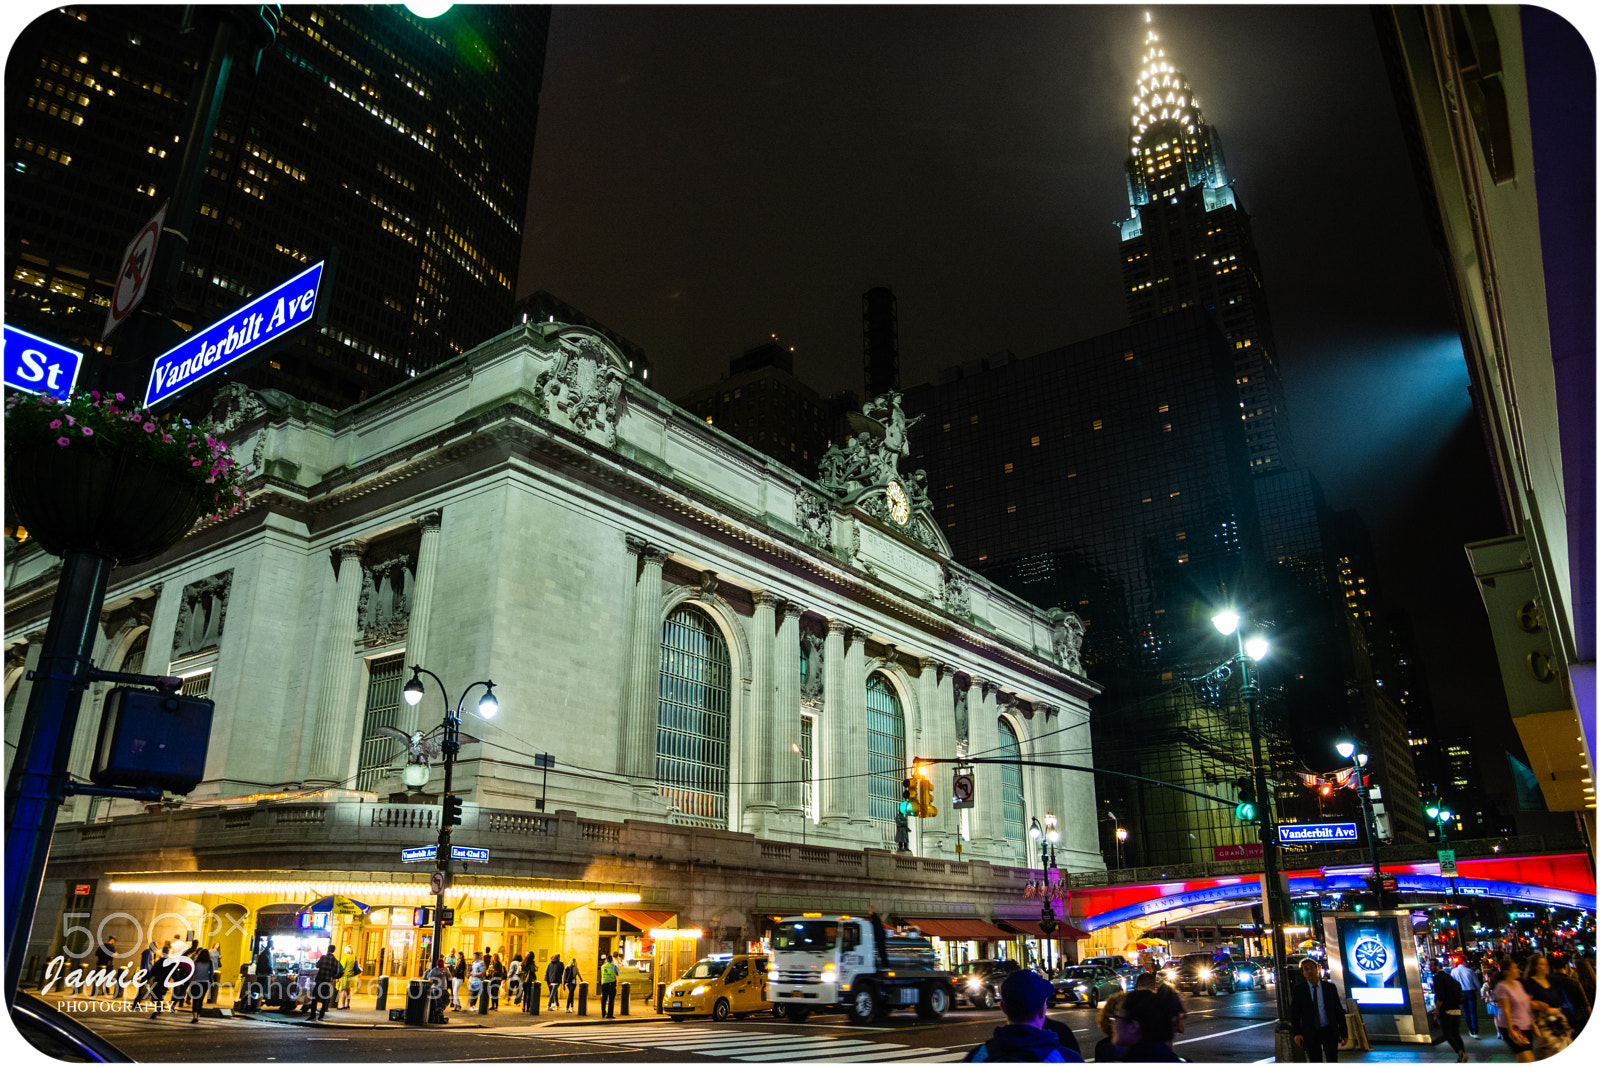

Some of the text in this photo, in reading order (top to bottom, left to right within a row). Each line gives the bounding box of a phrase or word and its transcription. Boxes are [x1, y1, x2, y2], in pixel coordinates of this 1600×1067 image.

[155, 288, 315, 394] Vanderbilt Ave
[17, 349, 63, 390] St
[1281, 827, 1355, 839] Vanderbilt Ave
[453, 849, 487, 859] East 42nd St
[1219, 849, 1245, 857] GRAND
[1441, 860, 1455, 869] 25
[1489, 884, 1531, 895] PLAZA
[1140, 899, 1175, 912] GRAND
[1181, 889, 1228, 903] CENTRAL
